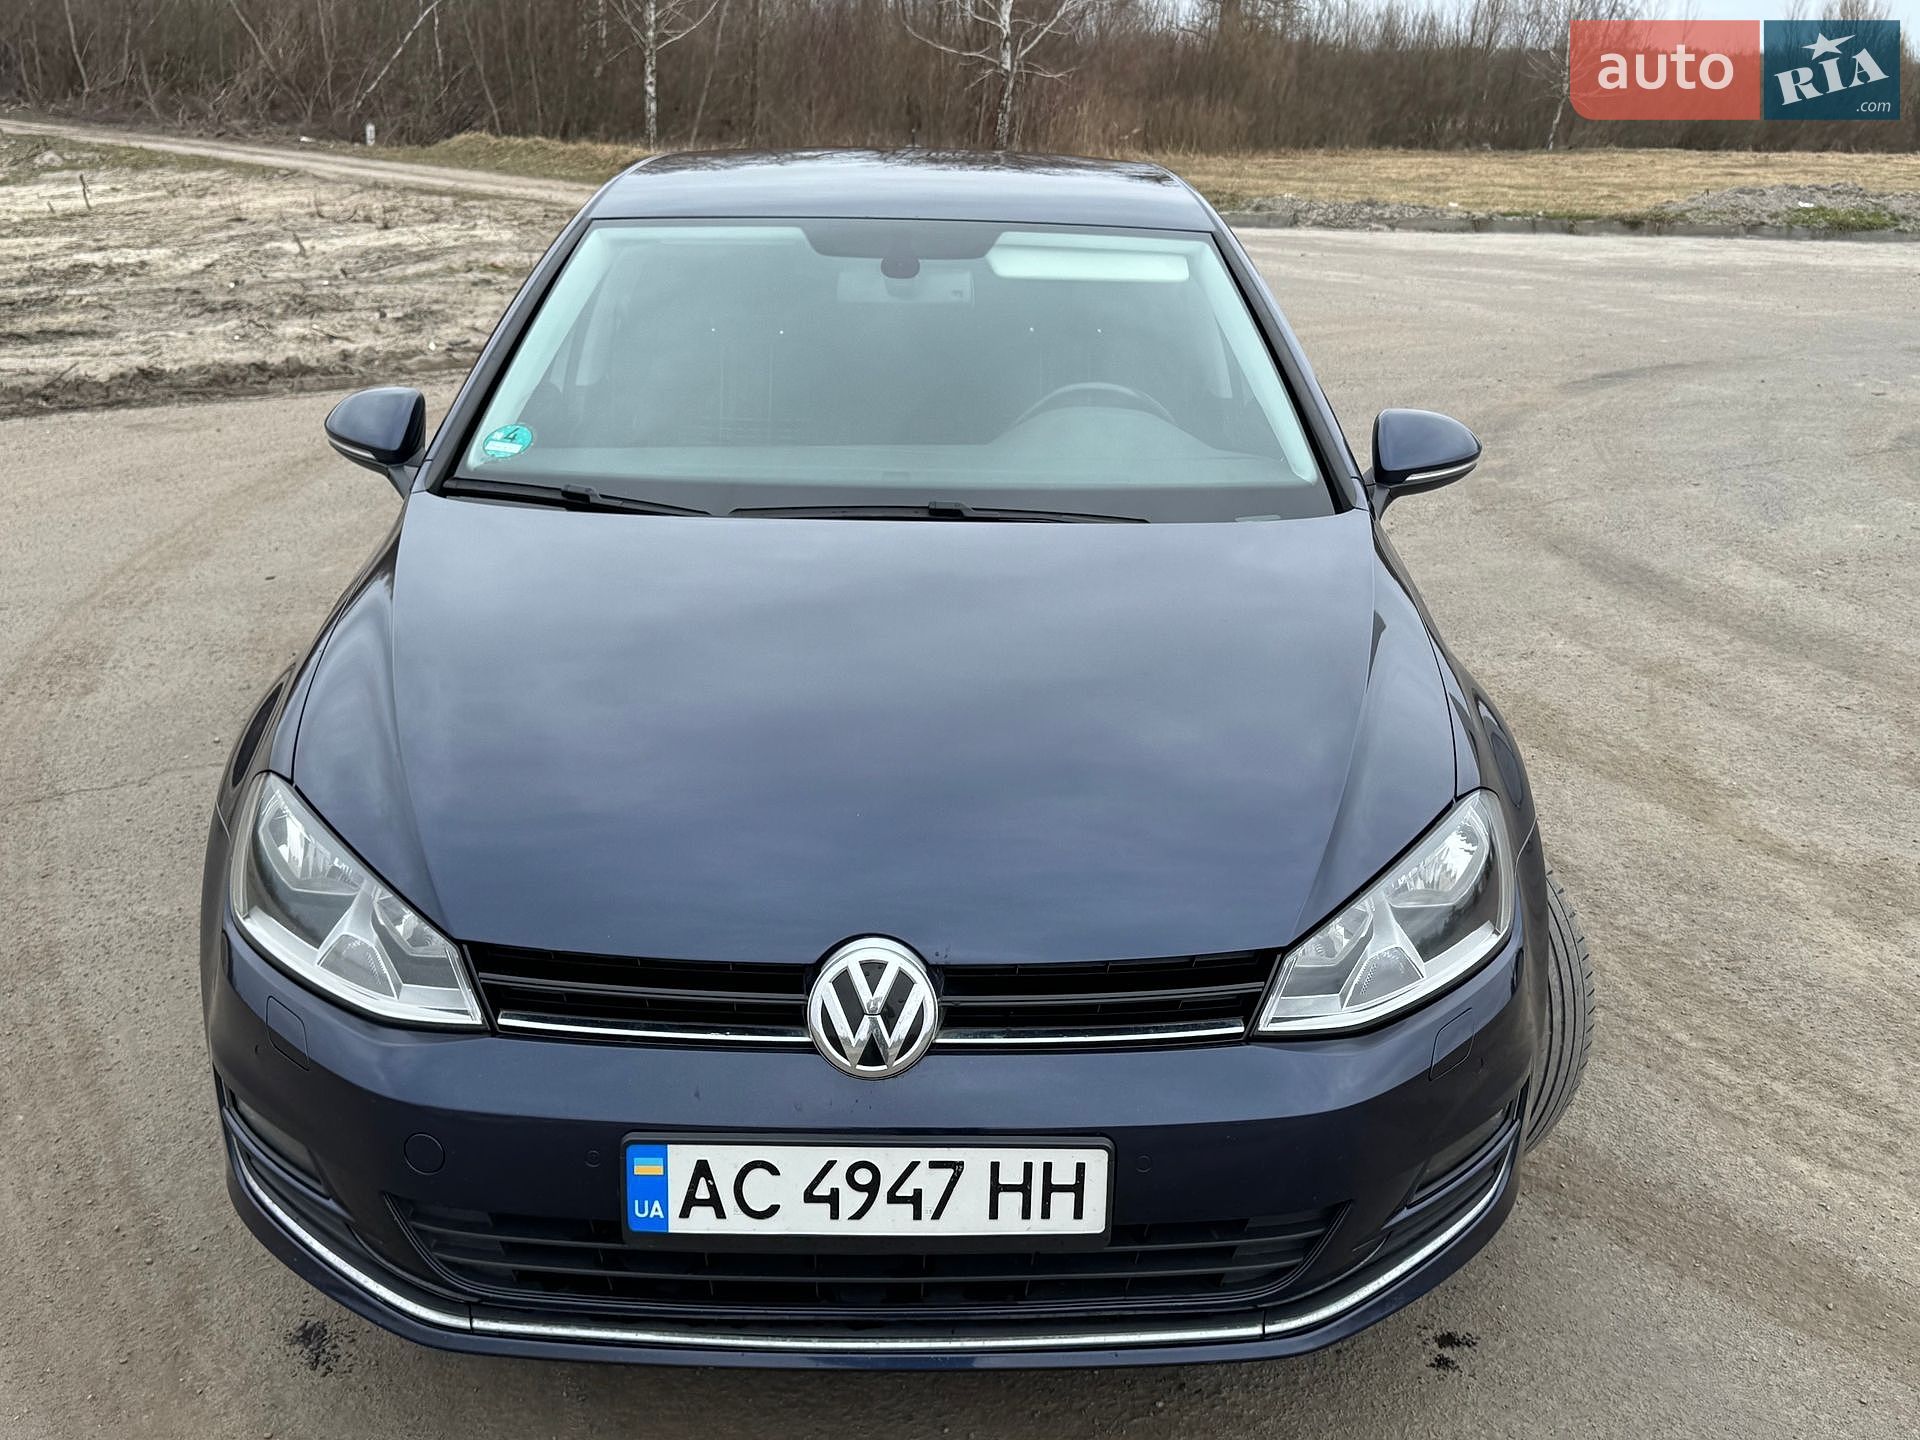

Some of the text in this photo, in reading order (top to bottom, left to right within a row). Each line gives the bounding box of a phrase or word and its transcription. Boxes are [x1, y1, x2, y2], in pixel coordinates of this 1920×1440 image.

[634, 1199, 665, 1219] UA
[678, 1159, 1086, 1221] AC 4947 HH
